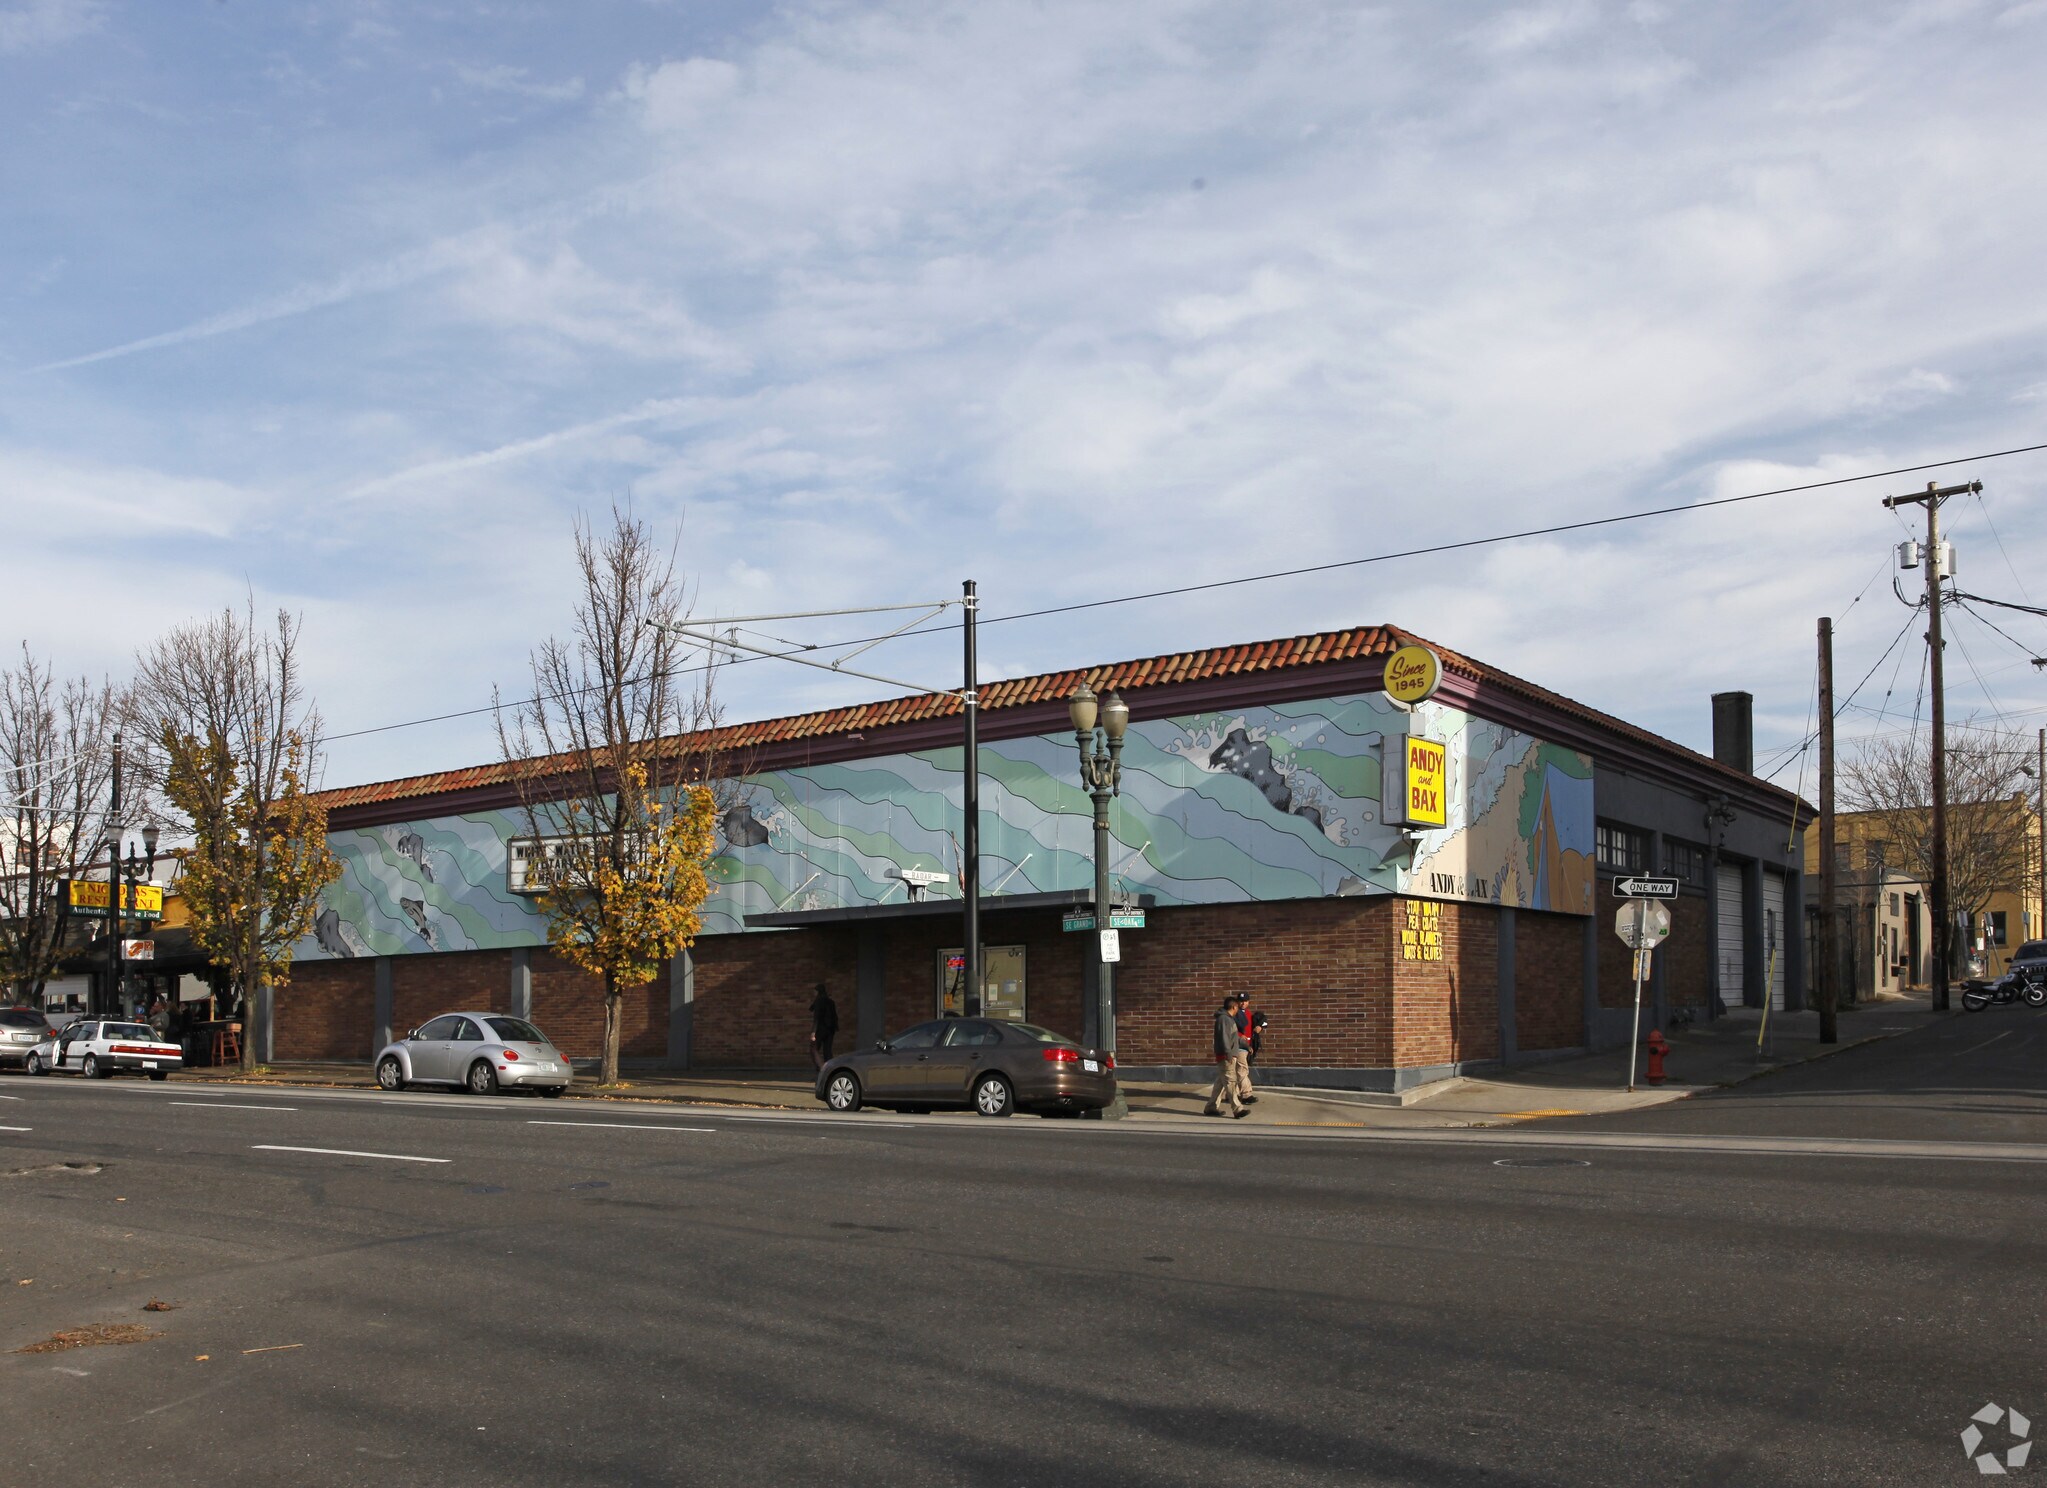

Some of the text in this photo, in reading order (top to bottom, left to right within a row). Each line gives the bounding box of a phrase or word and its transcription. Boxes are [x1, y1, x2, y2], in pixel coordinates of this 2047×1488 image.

[1389, 656, 1426, 680] Since
[1396, 678, 1425, 691] 1945
[1410, 746, 1443, 775] ANDY
[1418, 775, 1433, 786] and
[1412, 786, 1437, 813] BAX
[1430, 872, 1456, 895] ANDY
[1467, 878, 1488, 898] AX
[1630, 883, 1670, 892] ONE WAY
[73, 906, 107, 915] Authentic
[144, 911, 160, 919] Food
